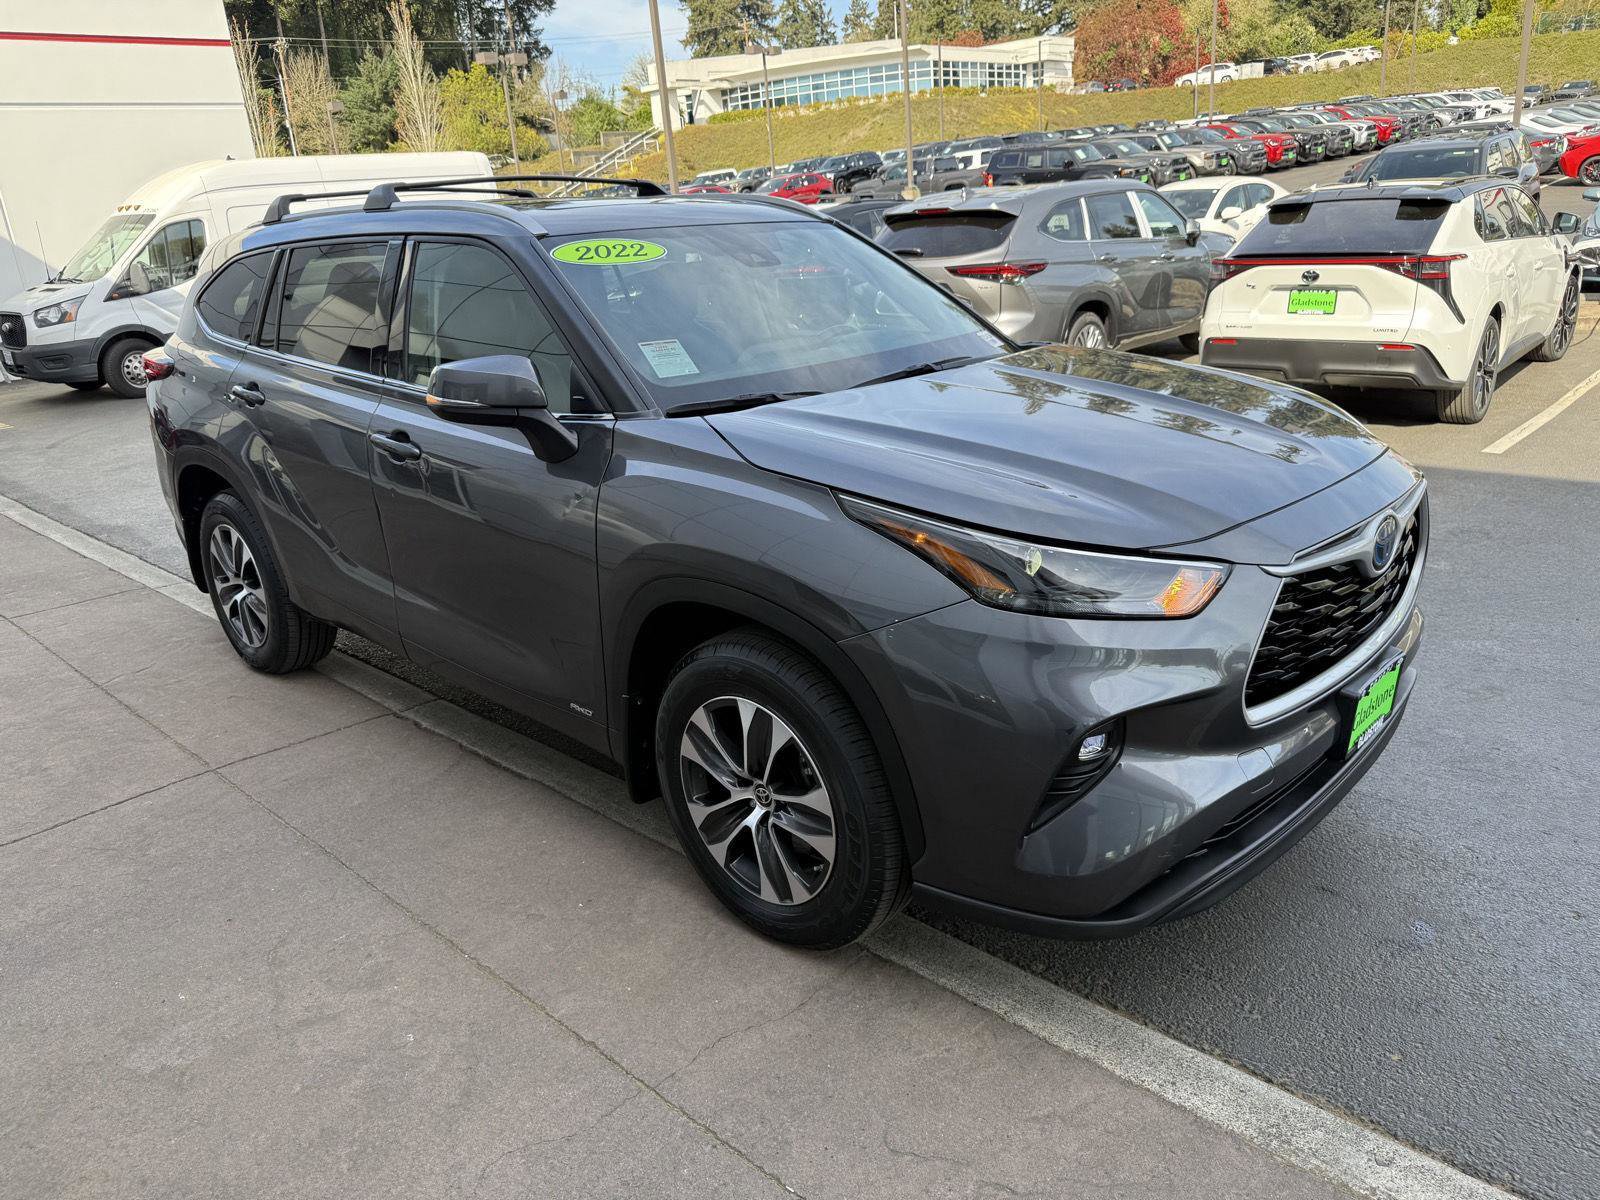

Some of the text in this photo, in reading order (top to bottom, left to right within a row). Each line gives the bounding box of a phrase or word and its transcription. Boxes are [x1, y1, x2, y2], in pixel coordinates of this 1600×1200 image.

[575, 243, 648, 261] 2022
[1291, 298, 1334, 307] Gladstone
[1354, 684, 1395, 731] Gladstone
